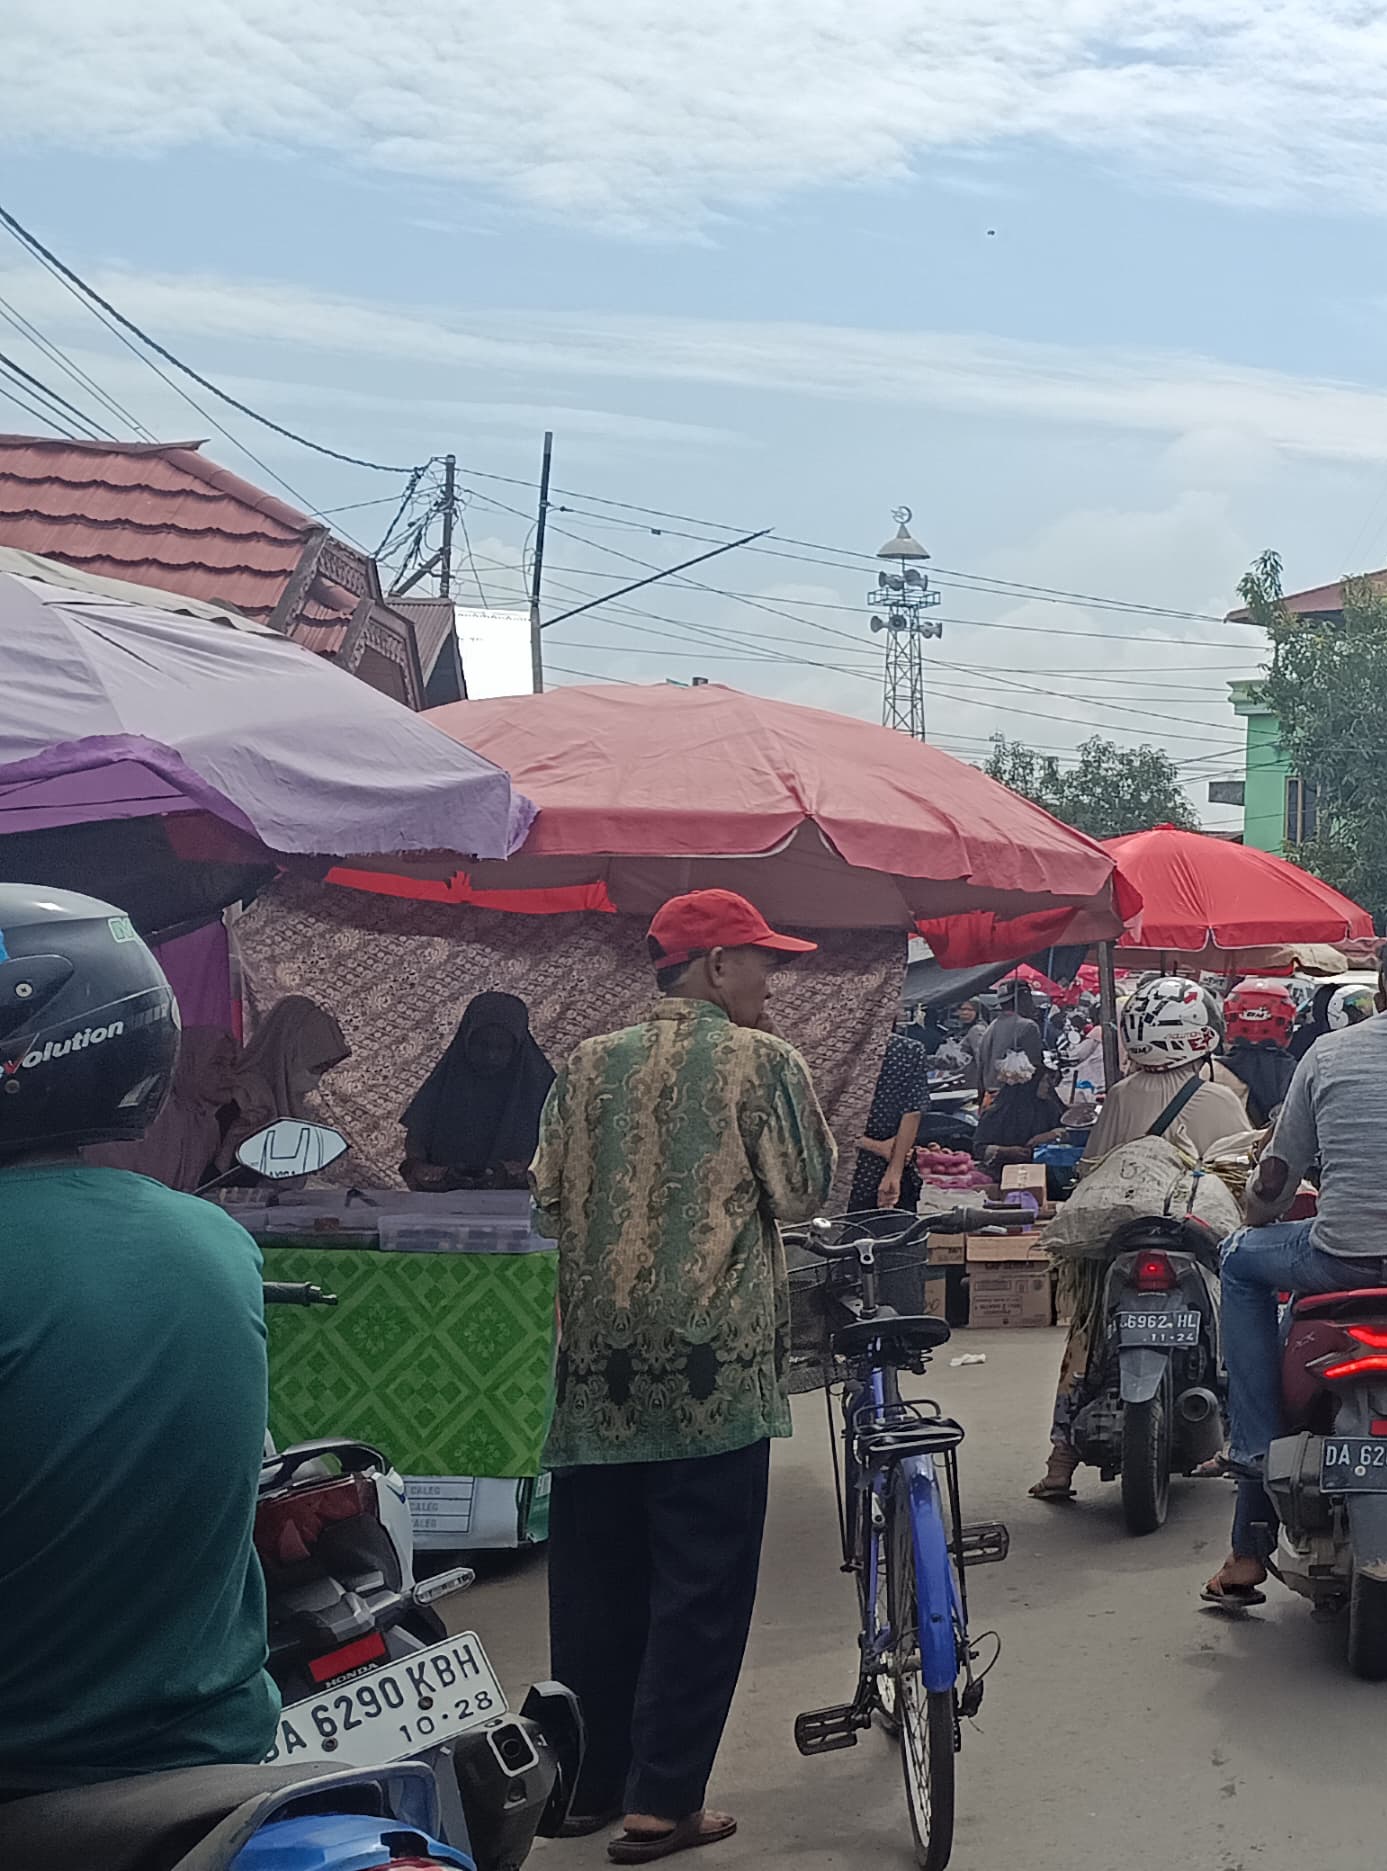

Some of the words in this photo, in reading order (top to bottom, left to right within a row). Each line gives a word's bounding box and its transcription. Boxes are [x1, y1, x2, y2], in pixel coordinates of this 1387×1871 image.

[1177, 1314, 1197, 1328] HL
[1325, 1444, 1350, 1467] DA
[324, 1661, 380, 1690] HONDA
[311, 1676, 405, 1738] 6290
[405, 1643, 481, 1699] KBH
